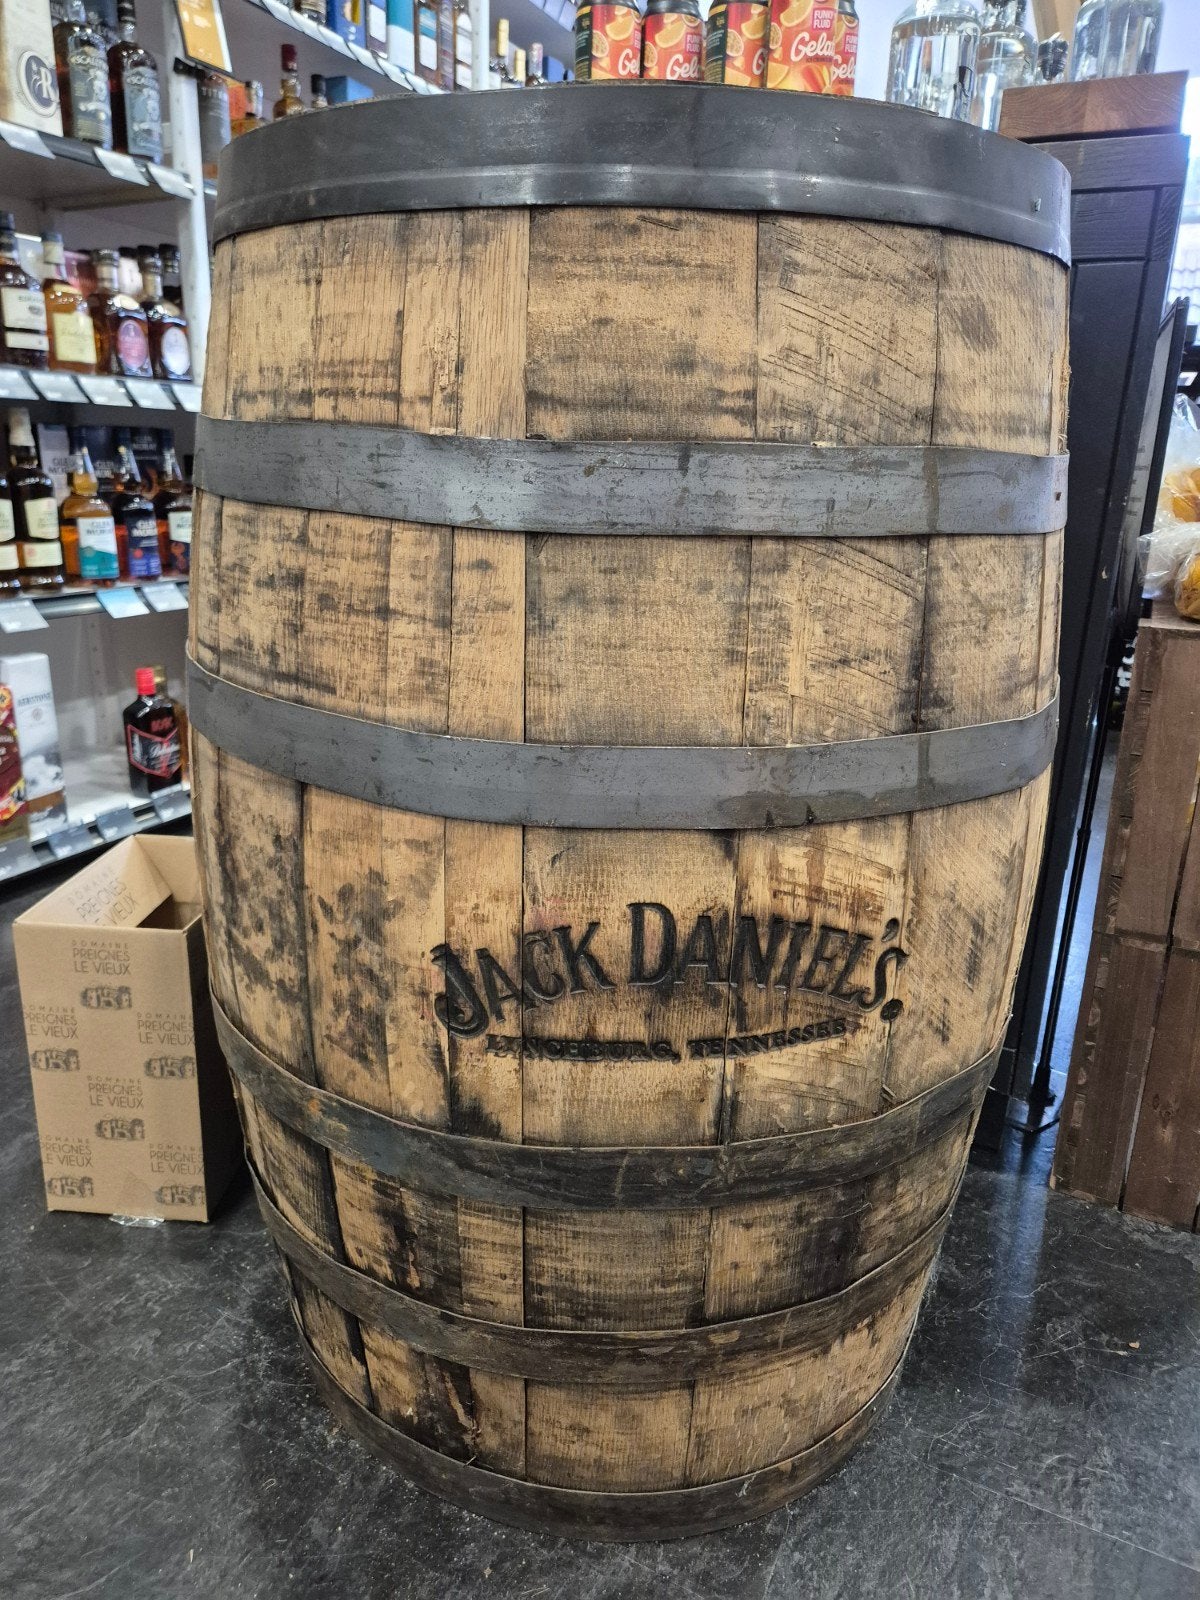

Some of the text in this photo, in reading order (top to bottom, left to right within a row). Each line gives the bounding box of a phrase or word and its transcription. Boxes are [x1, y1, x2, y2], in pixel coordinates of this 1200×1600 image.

[814, 10, 834, 20] FUNKY
[813, 19, 831, 29] FLUID
[790, 31, 837, 62] Gela
[618, 48, 640, 76] Gel
[72, 939, 129, 950] DOMAINE
[72, 947, 131, 962] PREIGNES
[74, 960, 131, 976] LE VIEUX
[429, 902, 910, 1039] JACK DANIEL'S
[25, 1004, 76, 1014] OMAINE
[137, 1012, 192, 1020] DOMAIN
[41, 1025, 79, 1040] VIEUX
[139, 1032, 196, 1046] LE VIEUX
[687, 1016, 852, 1060] TENNESSEE
[87, 1075, 141, 1085] DOMAINE
[88, 1083, 143, 1096] PREIGNES
[89, 1095, 144, 1109] LE VIEUX
[43, 1134, 90, 1144] OMAINE
[57, 1155, 94, 1168] VIEUX
[151, 1161, 165, 1173] LE
